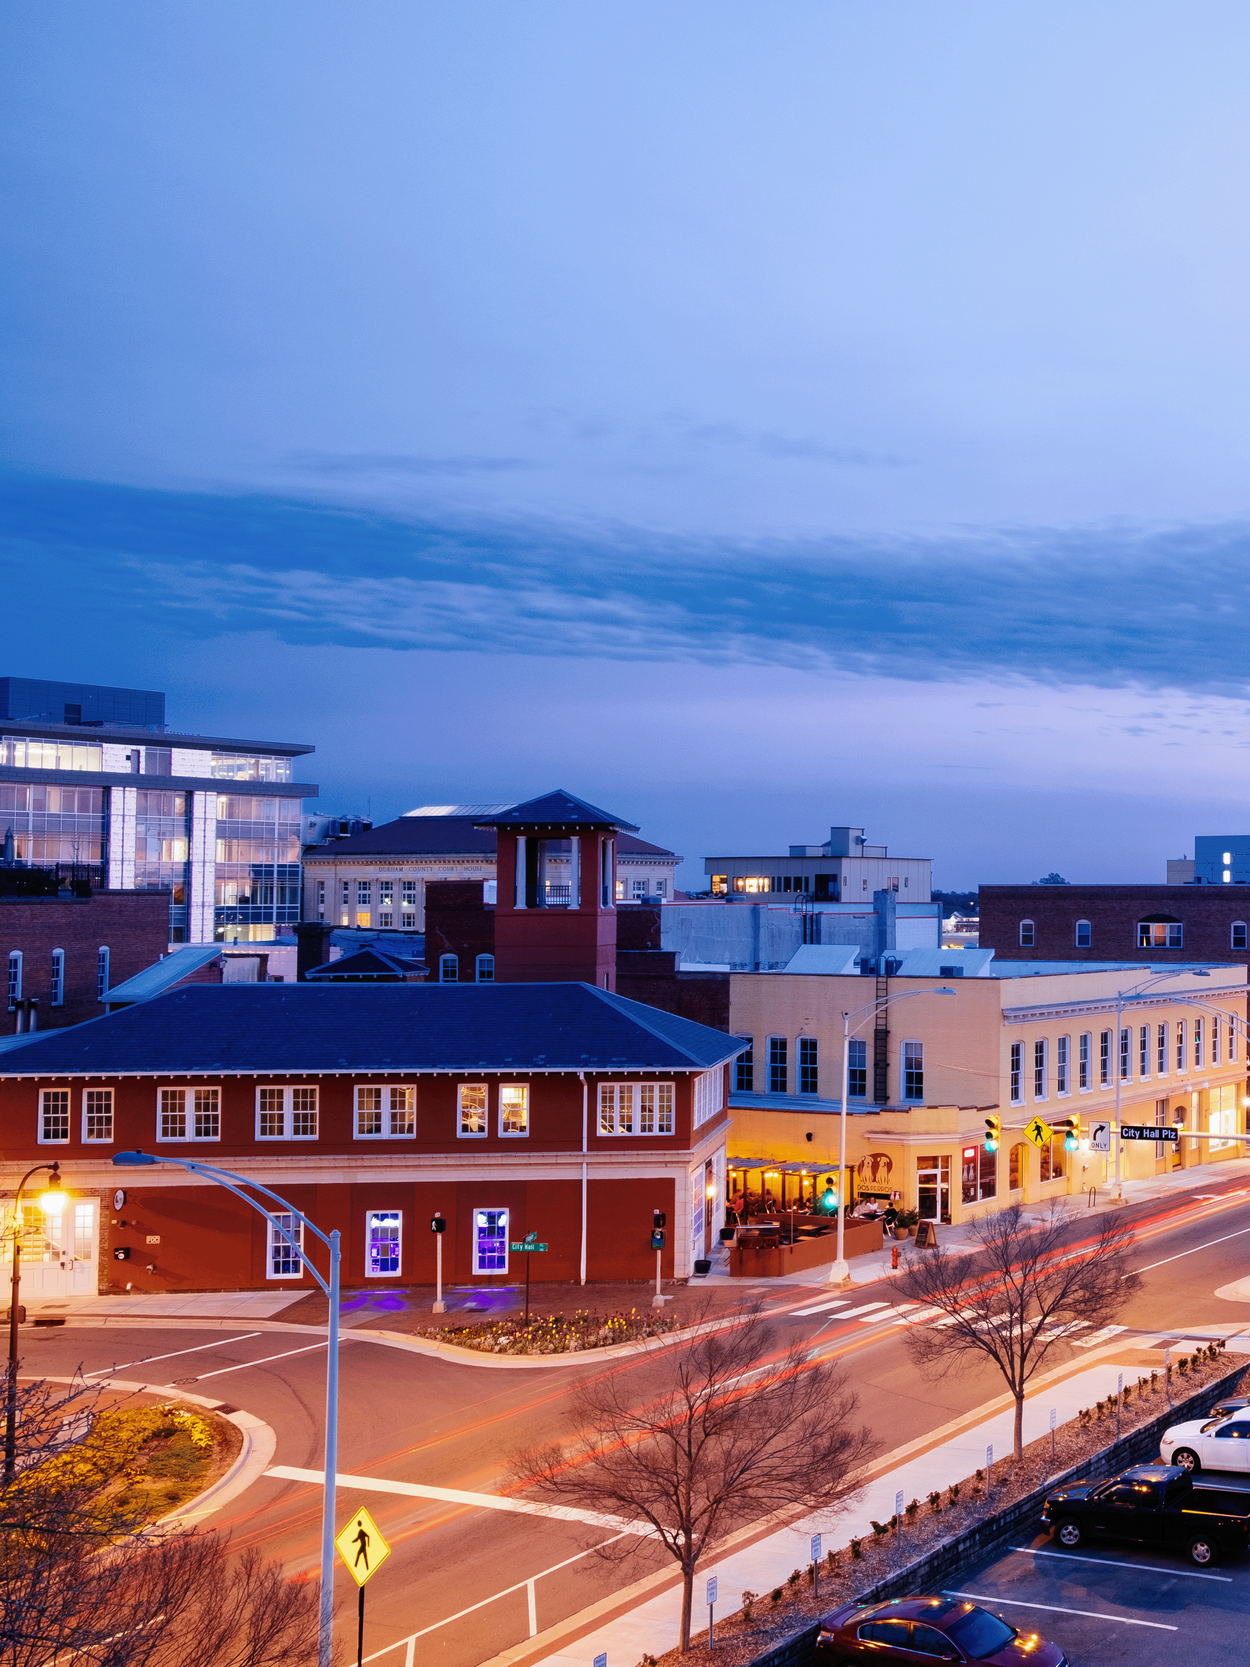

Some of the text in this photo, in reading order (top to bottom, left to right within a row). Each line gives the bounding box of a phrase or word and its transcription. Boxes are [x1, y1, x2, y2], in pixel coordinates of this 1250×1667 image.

[1122, 1127, 1176, 1139] City Hall Plz
[511, 1243, 523, 1251] City
